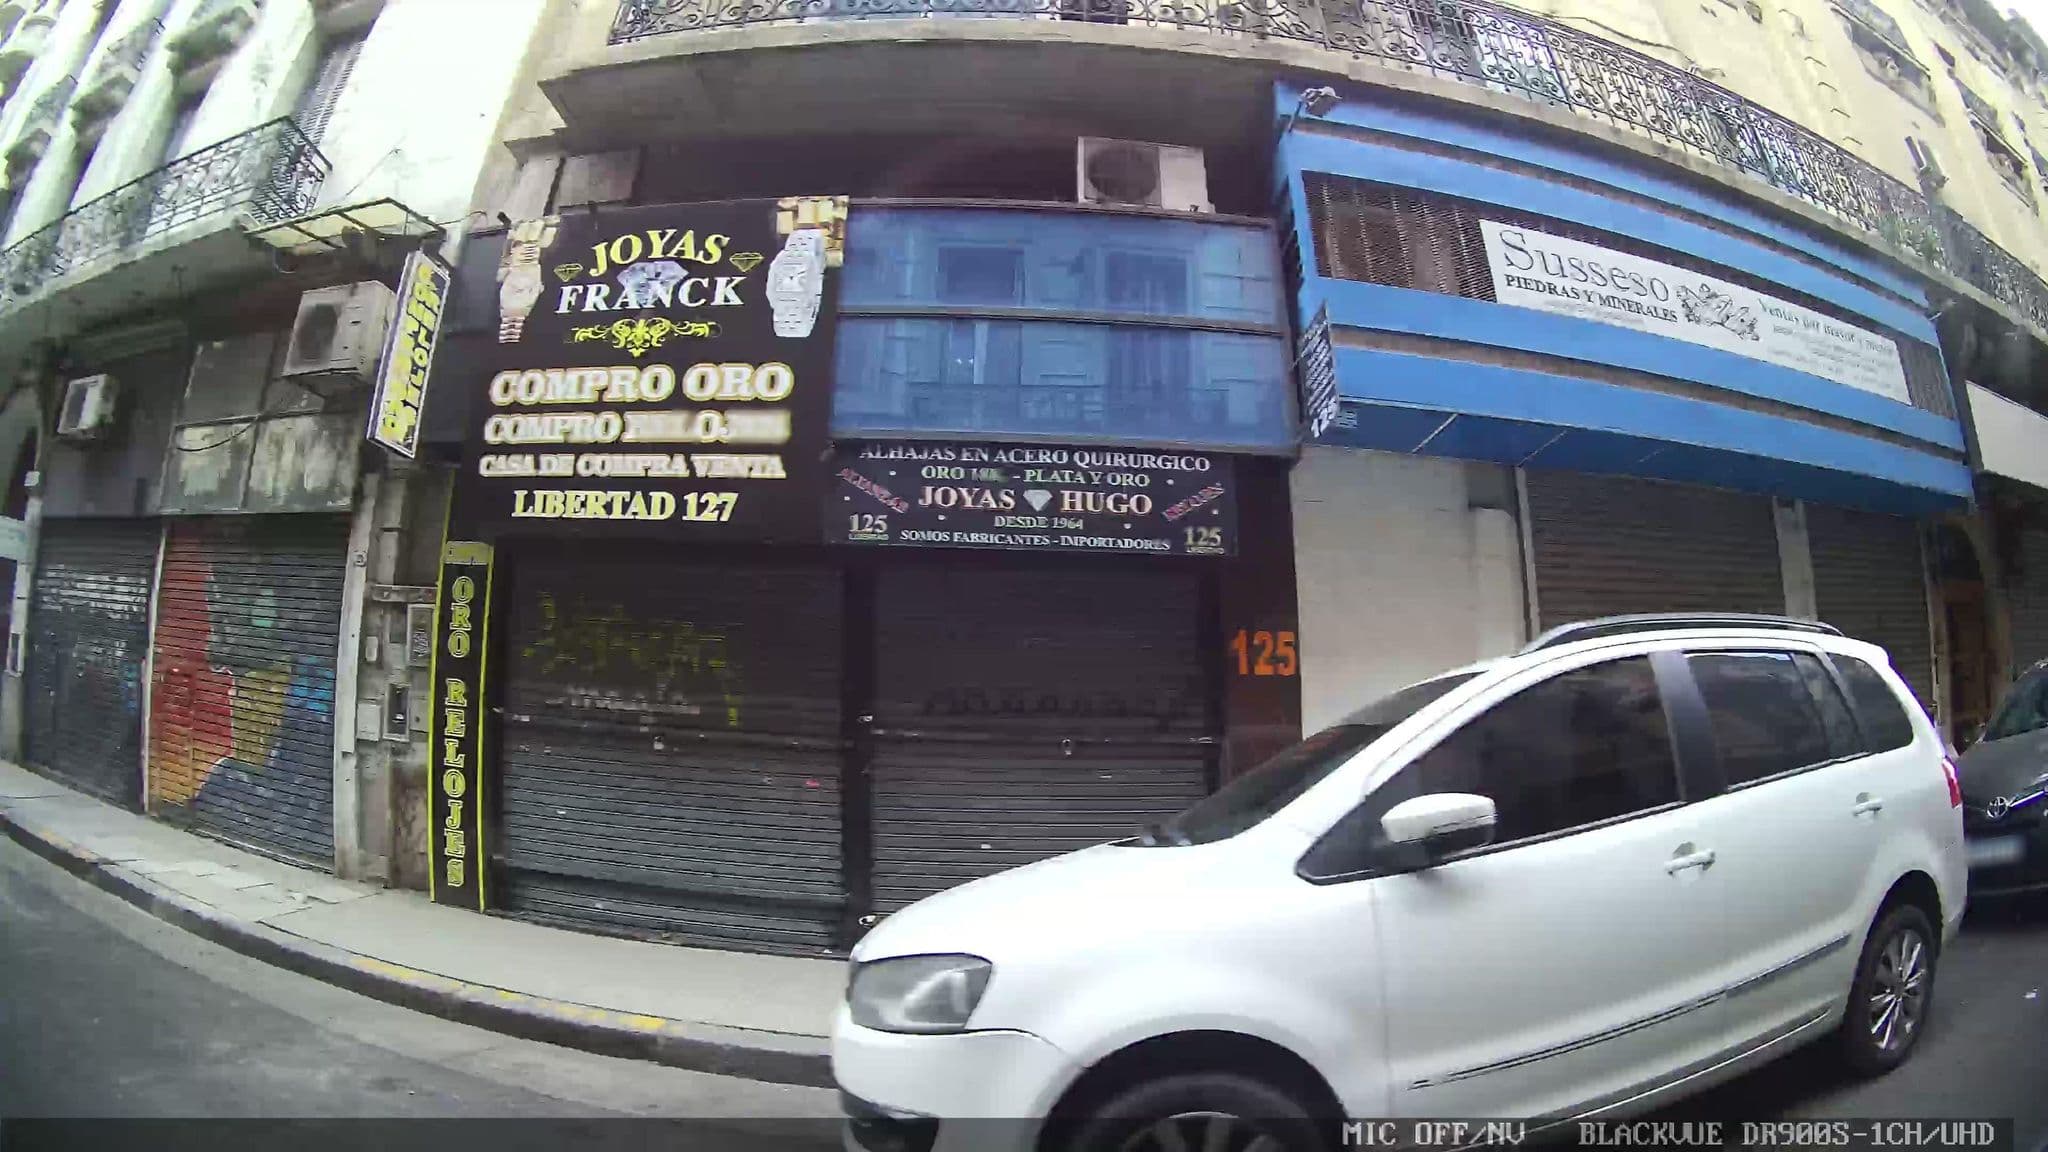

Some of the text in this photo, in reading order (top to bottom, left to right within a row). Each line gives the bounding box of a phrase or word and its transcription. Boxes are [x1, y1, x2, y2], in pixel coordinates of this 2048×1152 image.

[588, 229, 731, 277] JOYAS
[1499, 229, 1670, 302] Susseso
[553, 276, 747, 315] FRANCK
[1504, 274, 1581, 301] PIEDRAS
[1582, 289, 1595, 303] Y
[1598, 293, 1679, 323] MINERALES
[489, 362, 795, 406] COMPRO ORO
[484, 411, 623, 444] COMPRO
[479, 454, 787, 478] CASA DE COMPRA VENTA
[860, 446, 1210, 472] ALHAJAS EN ACERO QUIRURGICO
[921, 465, 965, 480] ORO
[1024, 469, 1085, 484] PLATA
[1088, 471, 1102, 485] Y
[1107, 473, 1150, 487] ORO
[511, 490, 738, 521] LIBERTAD 127
[918, 486, 1016, 511] JOYAS
[1060, 490, 1152, 515] HUGO
[850, 513, 888, 533] 125
[994, 515, 1083, 530] DESDE 1964
[1184, 526, 1222, 547] 125
[901, 530, 950, 542] SOMOS
[953, 532, 1050, 546] FABRICANTES
[1060, 535, 1171, 551] IMPORTADORES
[448, 576, 474, 658] ORO
[1232, 630, 1297, 676] 125
[443, 678, 467, 886] RELOJES
